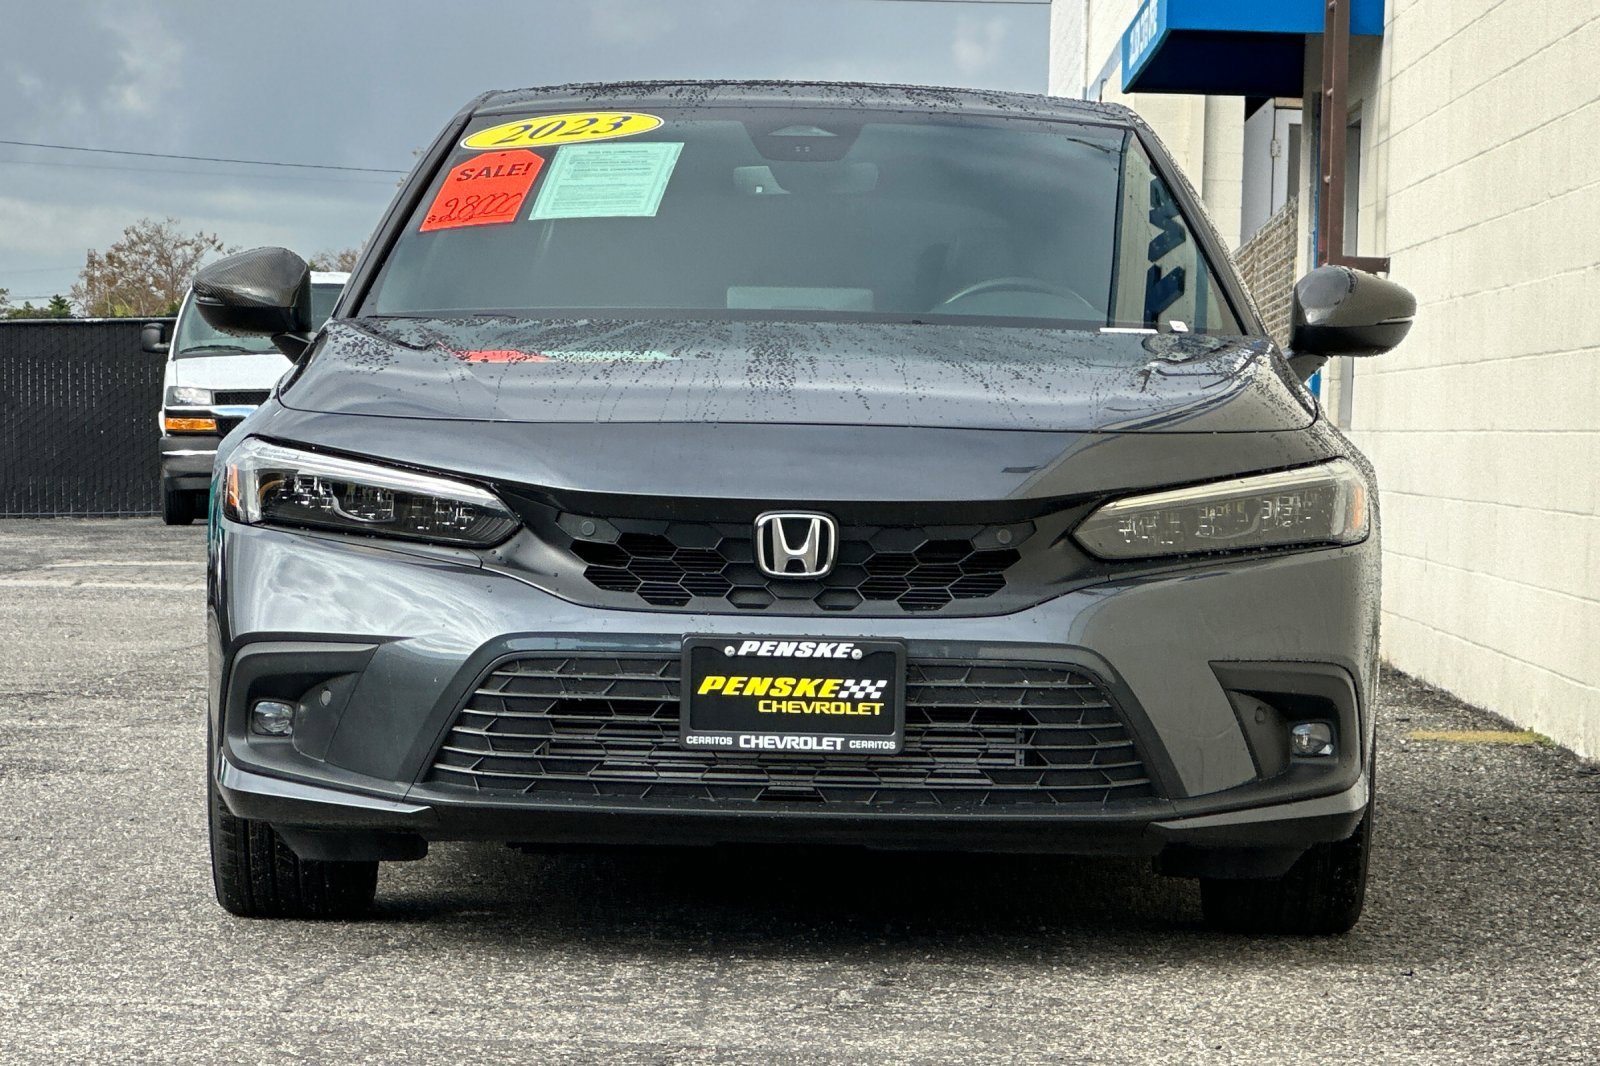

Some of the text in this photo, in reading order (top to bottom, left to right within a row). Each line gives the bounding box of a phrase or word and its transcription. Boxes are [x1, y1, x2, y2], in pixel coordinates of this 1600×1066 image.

[491, 115, 632, 145] 2023
[457, 162, 532, 182] SALE!
[737, 640, 854, 659] PENSKE
[697, 675, 846, 698] PENSKE
[758, 700, 884, 716] CHEVROLET
[686, 734, 896, 750] CERRITOS CHEVROLET CERRITOS
